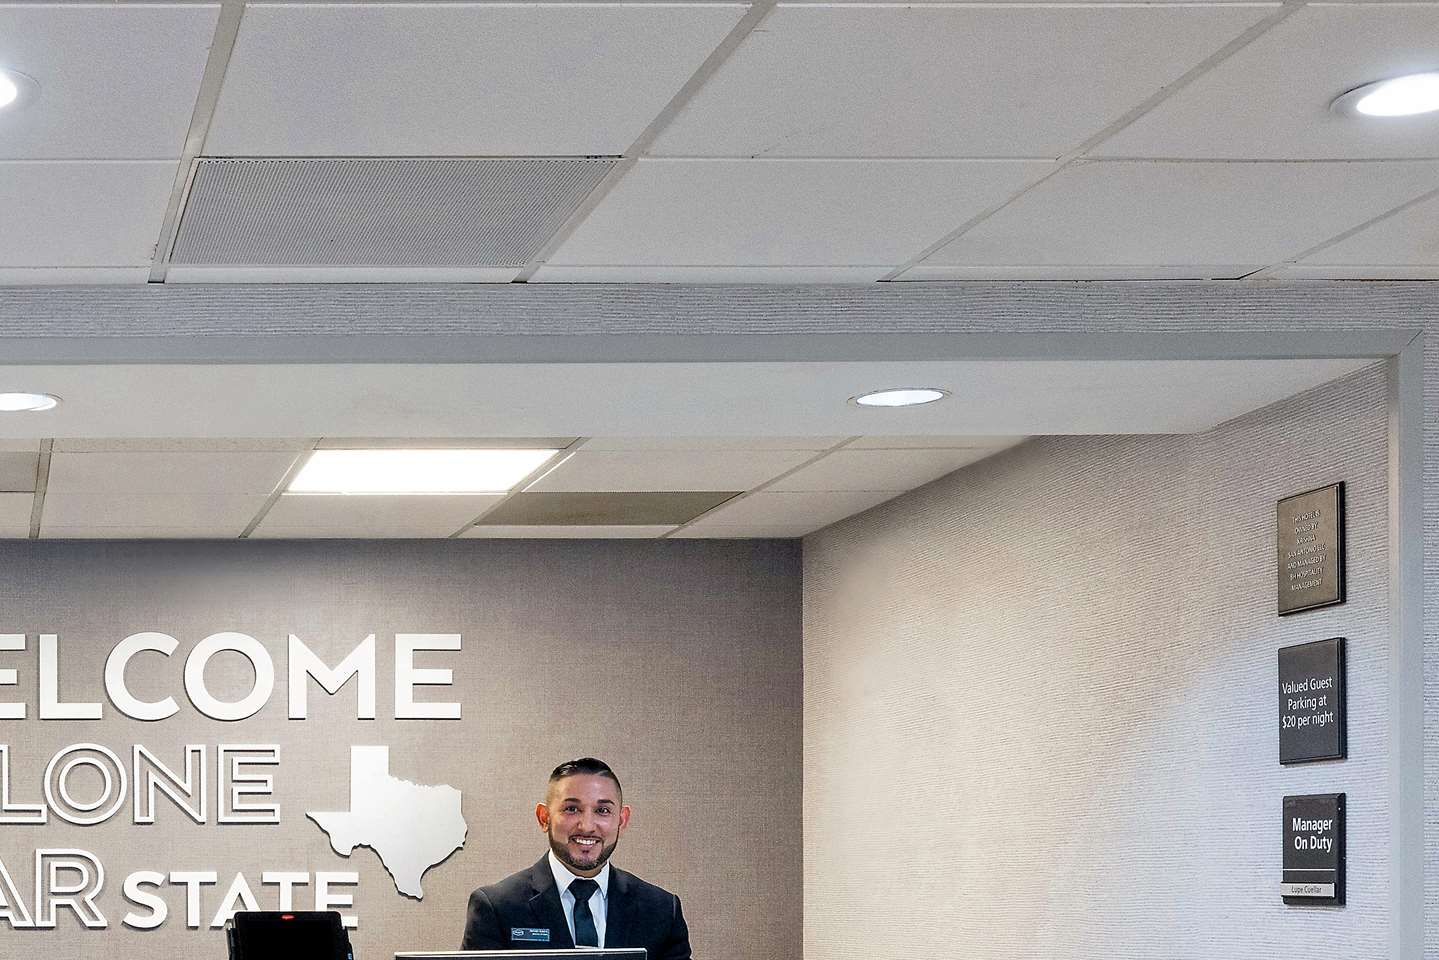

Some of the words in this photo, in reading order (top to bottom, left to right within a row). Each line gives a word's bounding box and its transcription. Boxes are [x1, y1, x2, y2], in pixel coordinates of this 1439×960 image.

[1282, 678, 1308, 694] Valued
[1310, 676, 1332, 690] Guest
[1288, 696, 1317, 711] Parking
[1318, 694, 1327, 706] at
[1282, 715, 1296, 730] $20
[1297, 716, 1310, 729] per
[1312, 711, 1333, 727] night
[1292, 817, 1333, 834] Manager
[1294, 836, 1308, 850] On
[1310, 836, 1333, 853] Duty
